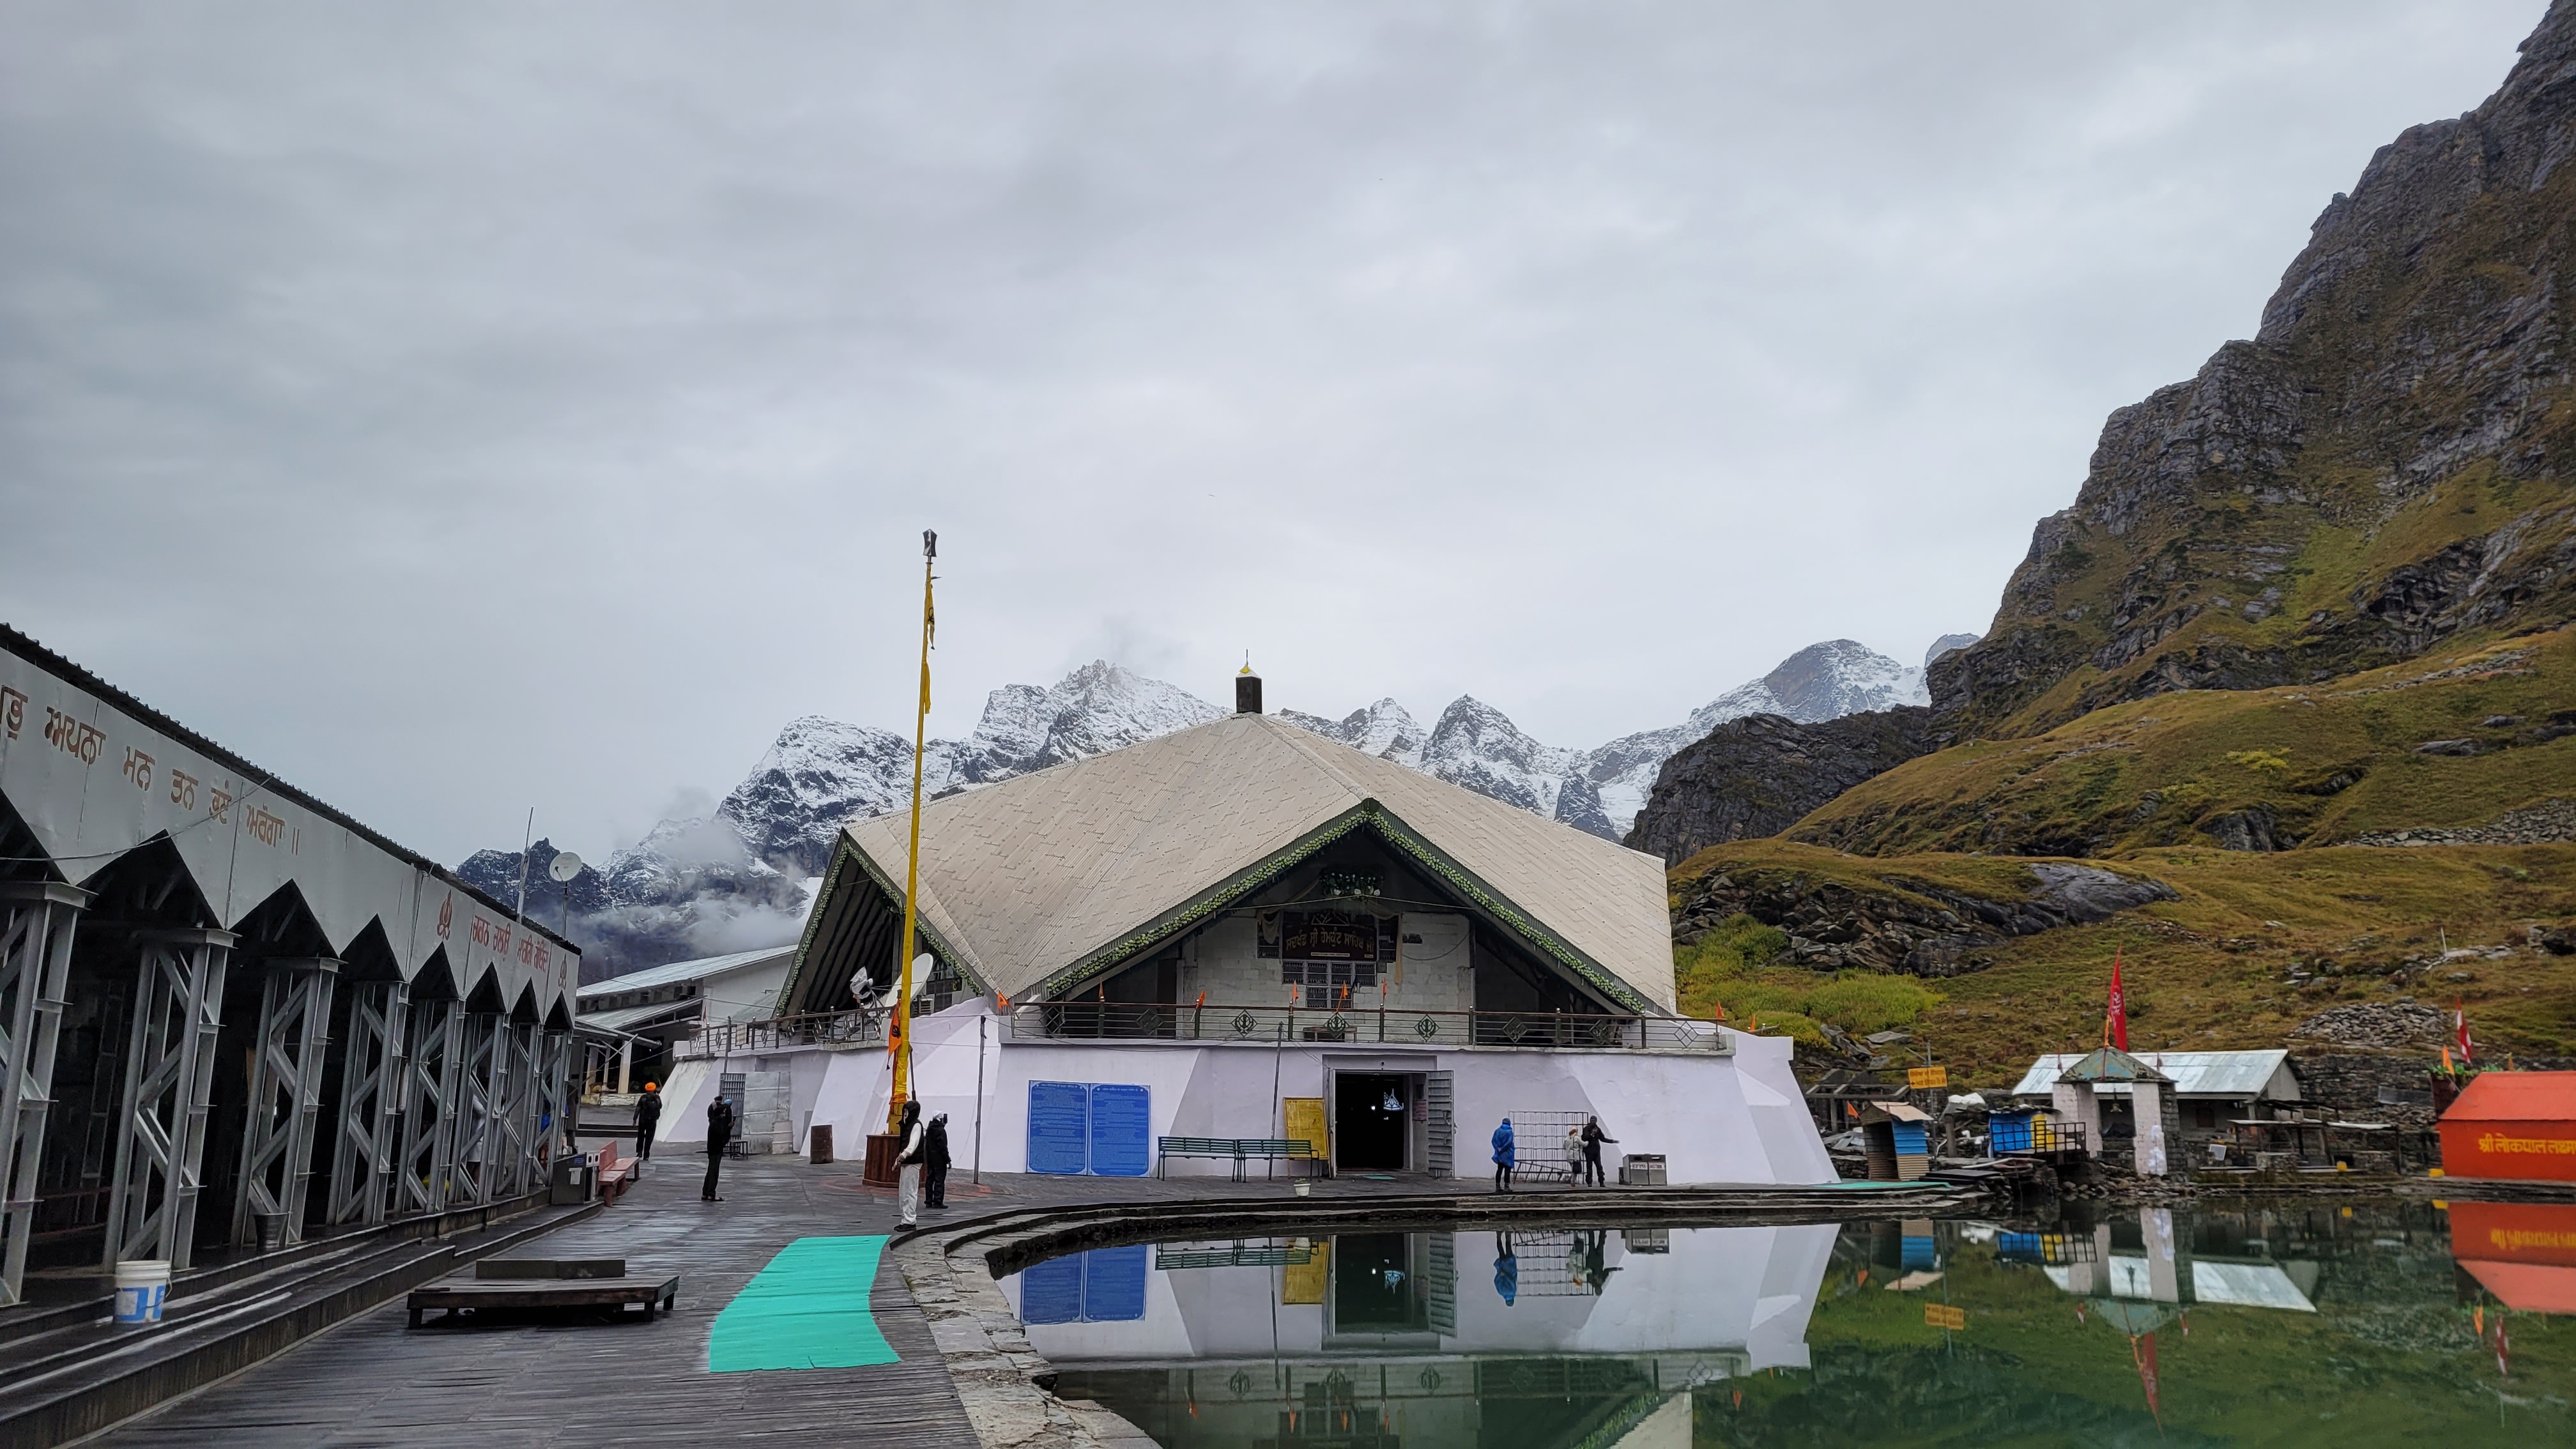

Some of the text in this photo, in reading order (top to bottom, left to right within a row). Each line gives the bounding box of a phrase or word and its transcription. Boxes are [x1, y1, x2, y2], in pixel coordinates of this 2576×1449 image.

[123, 746, 156, 792] ਮਨ
[170, 769, 199, 811] ਤਨ
[246, 802, 286, 848] ਅਰੋਗਾ
